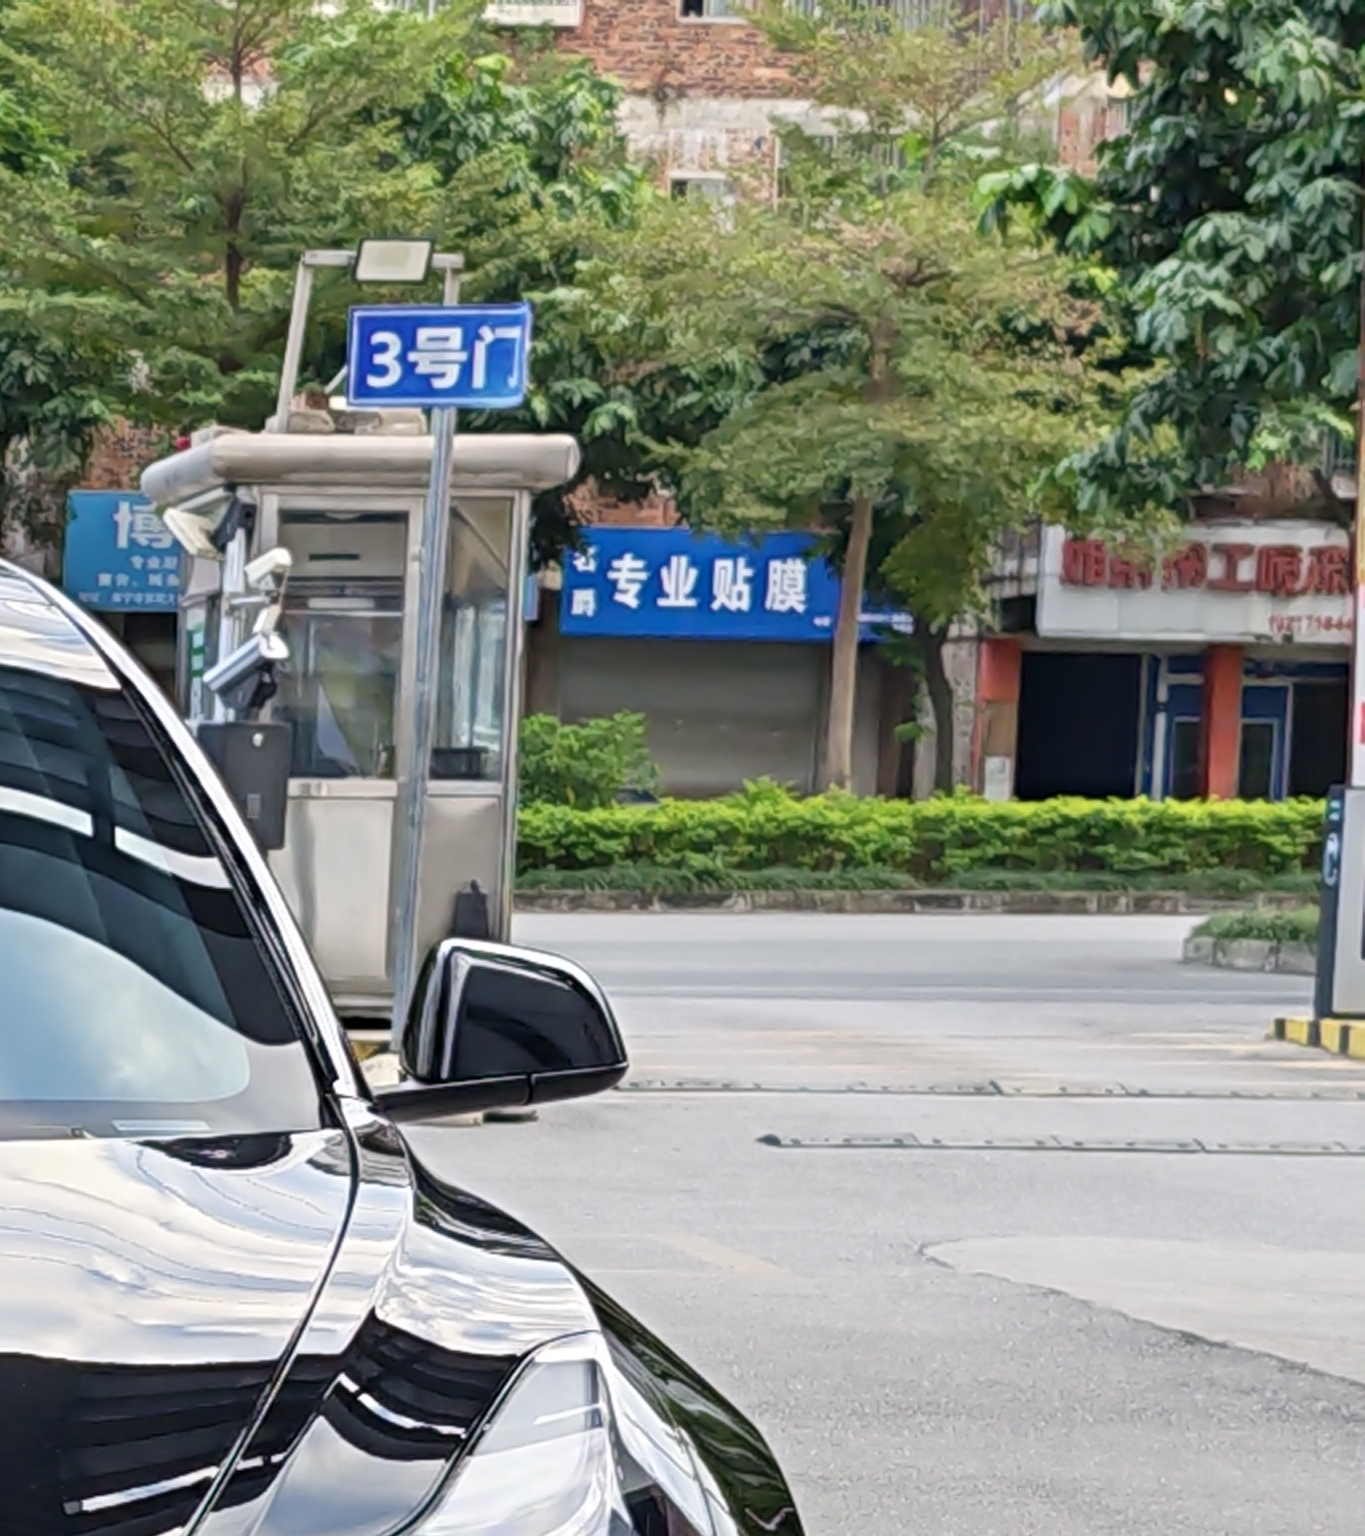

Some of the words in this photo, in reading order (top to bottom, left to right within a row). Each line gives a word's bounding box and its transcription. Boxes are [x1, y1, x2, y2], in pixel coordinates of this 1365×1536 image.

[366, 325, 523, 389] 3号门
[606, 552, 808, 616] 专业贴膜
